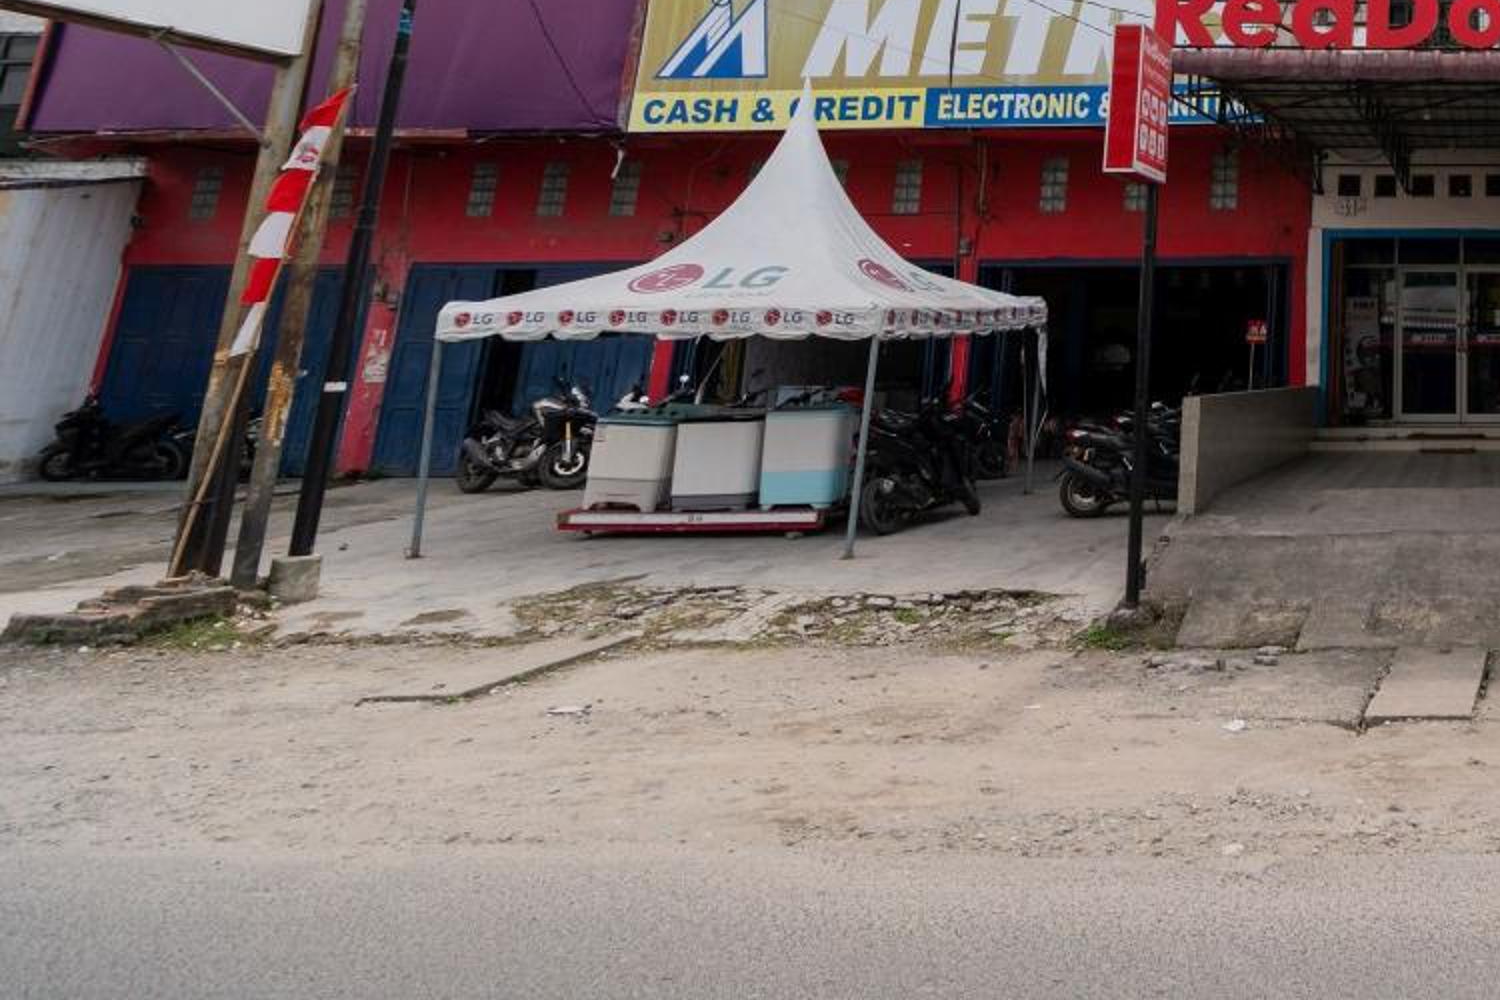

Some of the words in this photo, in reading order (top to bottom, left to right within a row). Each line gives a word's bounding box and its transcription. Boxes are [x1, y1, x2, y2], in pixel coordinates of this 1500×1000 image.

[643, 95, 738, 125] CASH
[750, 96, 776, 123] &
[937, 91, 1090, 121] ELECTRONIC
[701, 265, 791, 289] LG
